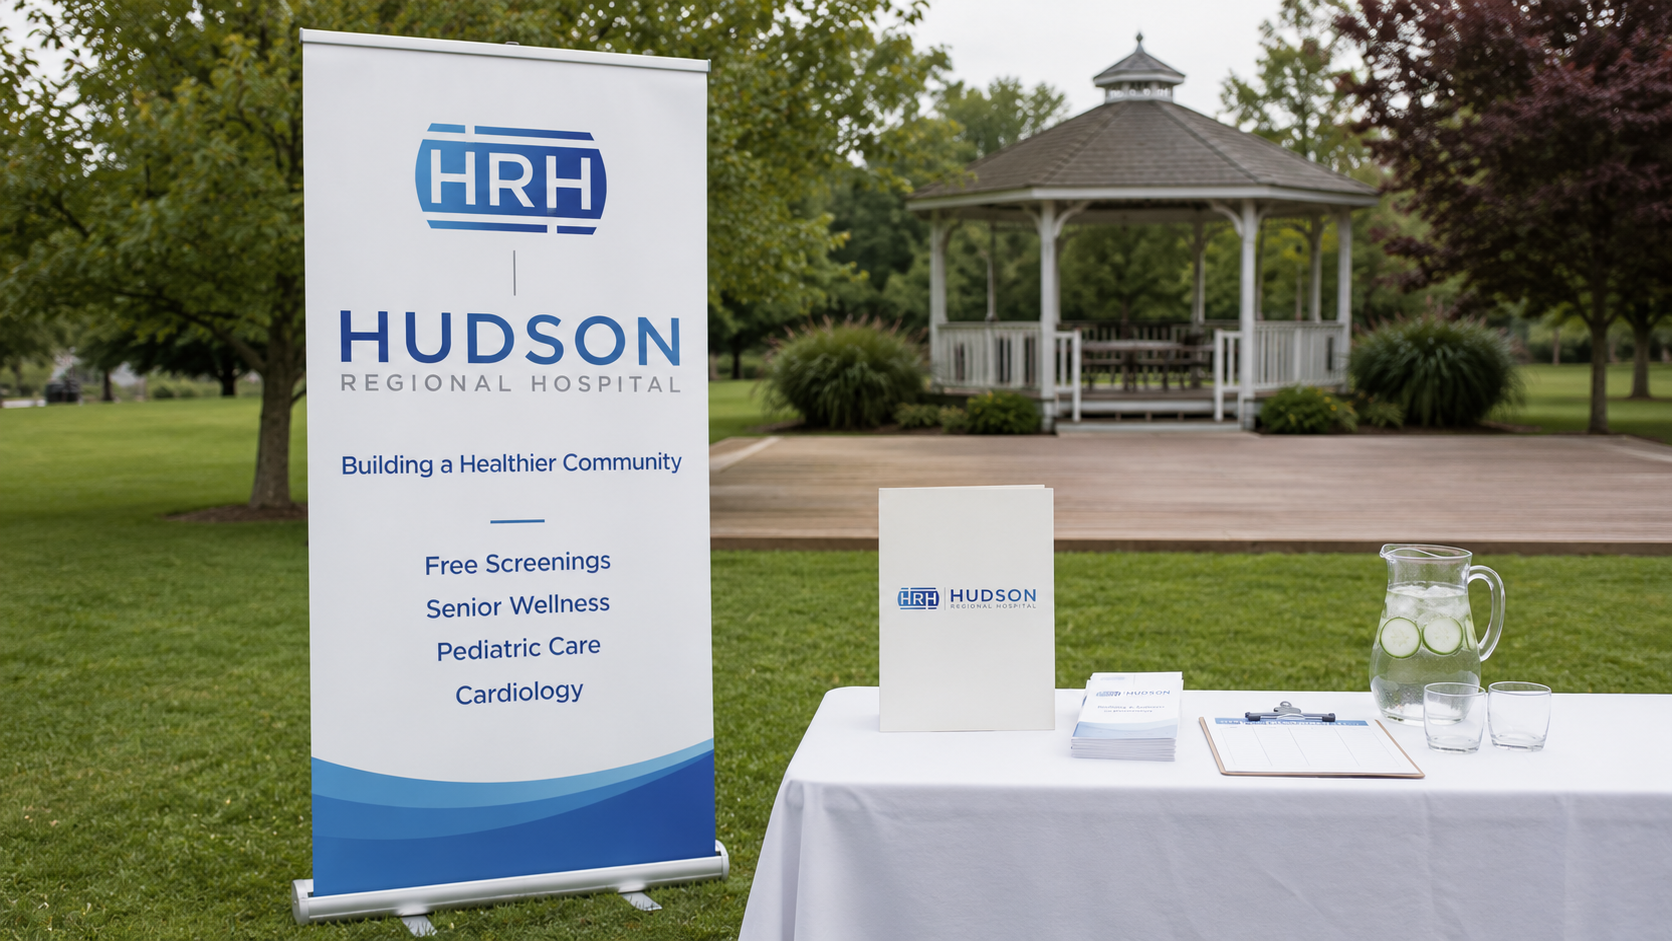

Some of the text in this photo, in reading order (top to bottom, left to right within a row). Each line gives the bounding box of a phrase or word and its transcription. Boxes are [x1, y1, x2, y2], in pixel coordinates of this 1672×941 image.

[430, 148, 592, 211] HRH
[340, 309, 681, 367] HUDSON
[340, 373, 681, 393] REGIONAL HOSPITAL
[342, 451, 683, 479] Building a Healthier Community
[425, 550, 611, 576] Free Screenings
[426, 593, 611, 620] Senior Wellness
[899, 591, 937, 605] HRH
[950, 588, 1037, 603] HUDSON
[437, 636, 601, 662] Pediatric Care
[455, 680, 584, 706] Cardiology
